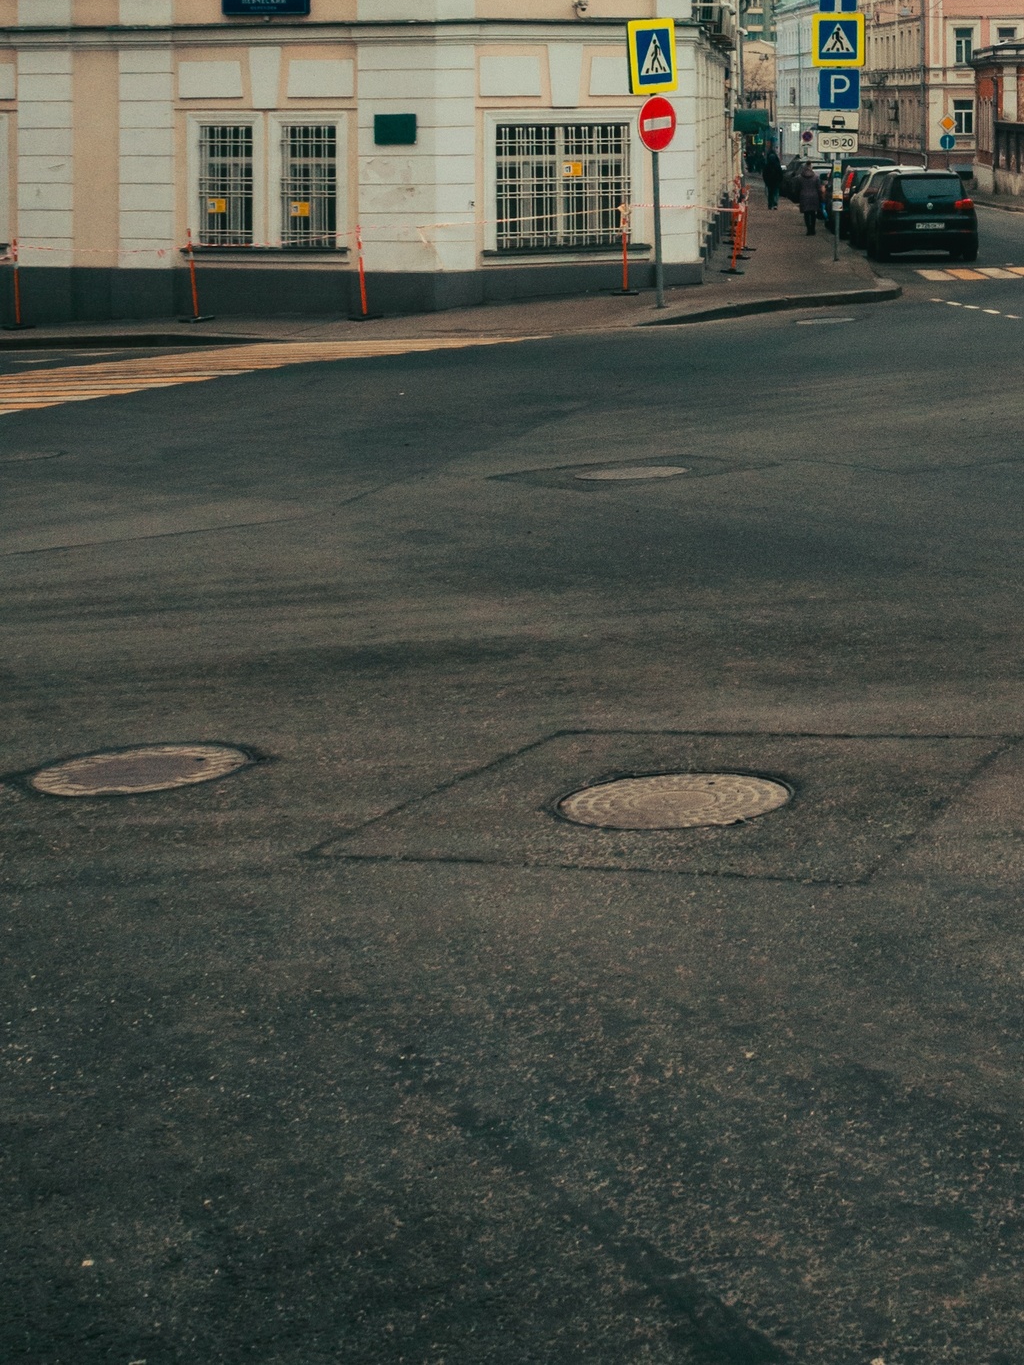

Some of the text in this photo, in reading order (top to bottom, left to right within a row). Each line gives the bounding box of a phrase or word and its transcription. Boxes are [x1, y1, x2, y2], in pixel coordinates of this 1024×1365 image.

[830, 75, 850, 103] P
[831, 138, 839, 146] 15
[841, 138, 853, 147] 20
